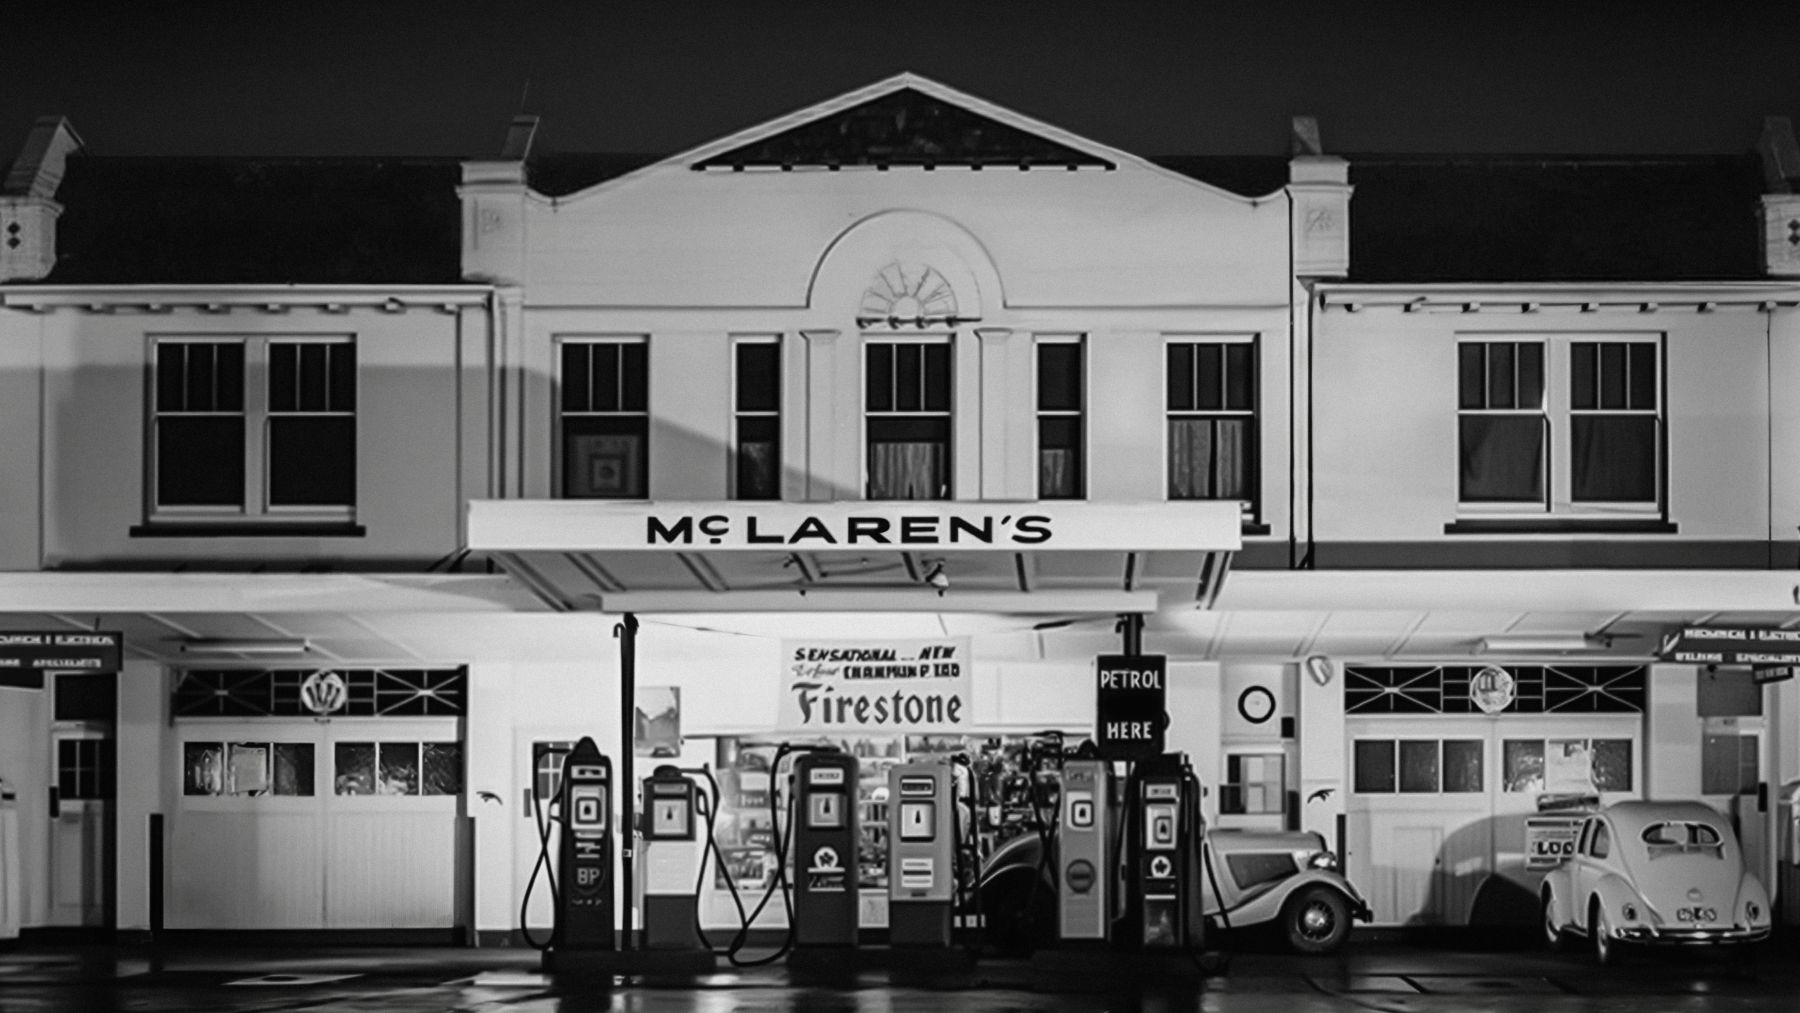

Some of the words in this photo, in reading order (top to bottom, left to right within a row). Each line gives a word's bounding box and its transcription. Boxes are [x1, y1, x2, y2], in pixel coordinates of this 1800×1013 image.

[794, 648, 897, 662] SENSATIONAL
[919, 646, 956, 660] NEW
[844, 665, 917, 680] CHAMPION
[1101, 670, 1161, 688] PETROL
[792, 682, 962, 724] Firestone
[1107, 721, 1152, 739] HERE
[577, 867, 600, 885] BP
